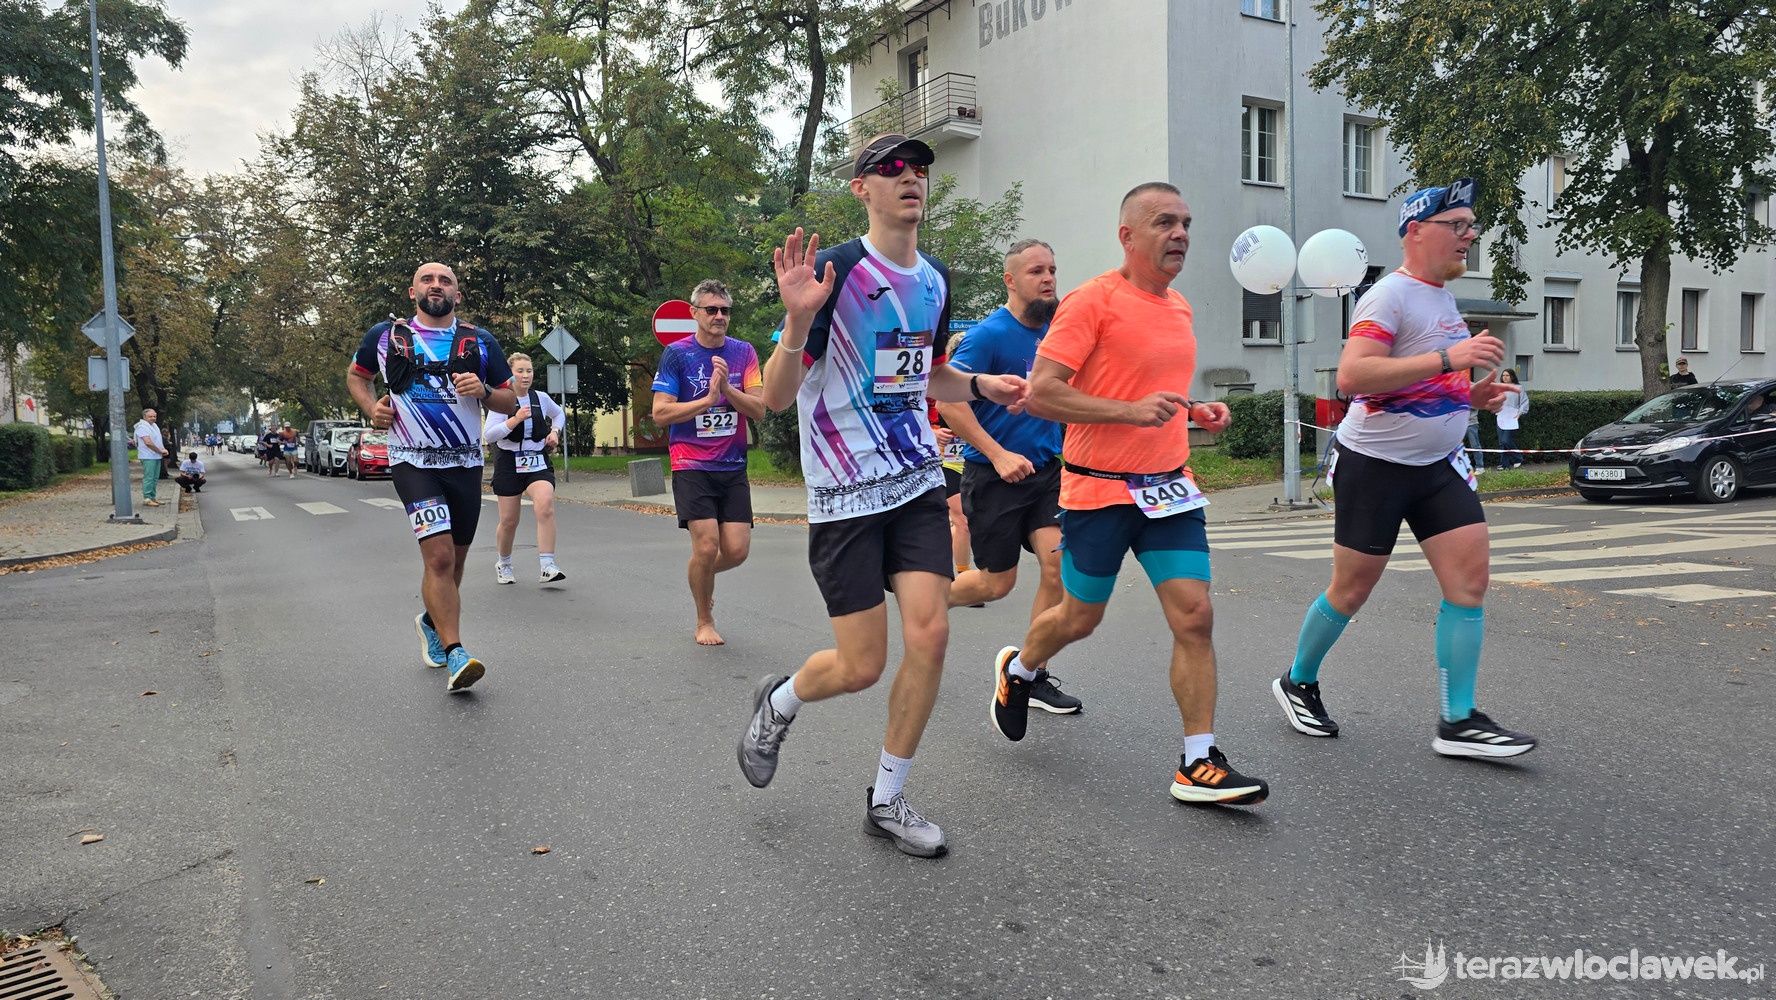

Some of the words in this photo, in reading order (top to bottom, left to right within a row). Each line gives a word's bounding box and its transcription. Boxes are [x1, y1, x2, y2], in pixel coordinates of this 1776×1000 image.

[896, 349, 924, 375] 28
[702, 413, 733, 428] 522
[950, 444, 965, 455] 42
[520, 456, 539, 467] 271
[1142, 482, 1189, 507] 640
[415, 506, 447, 526] 400
